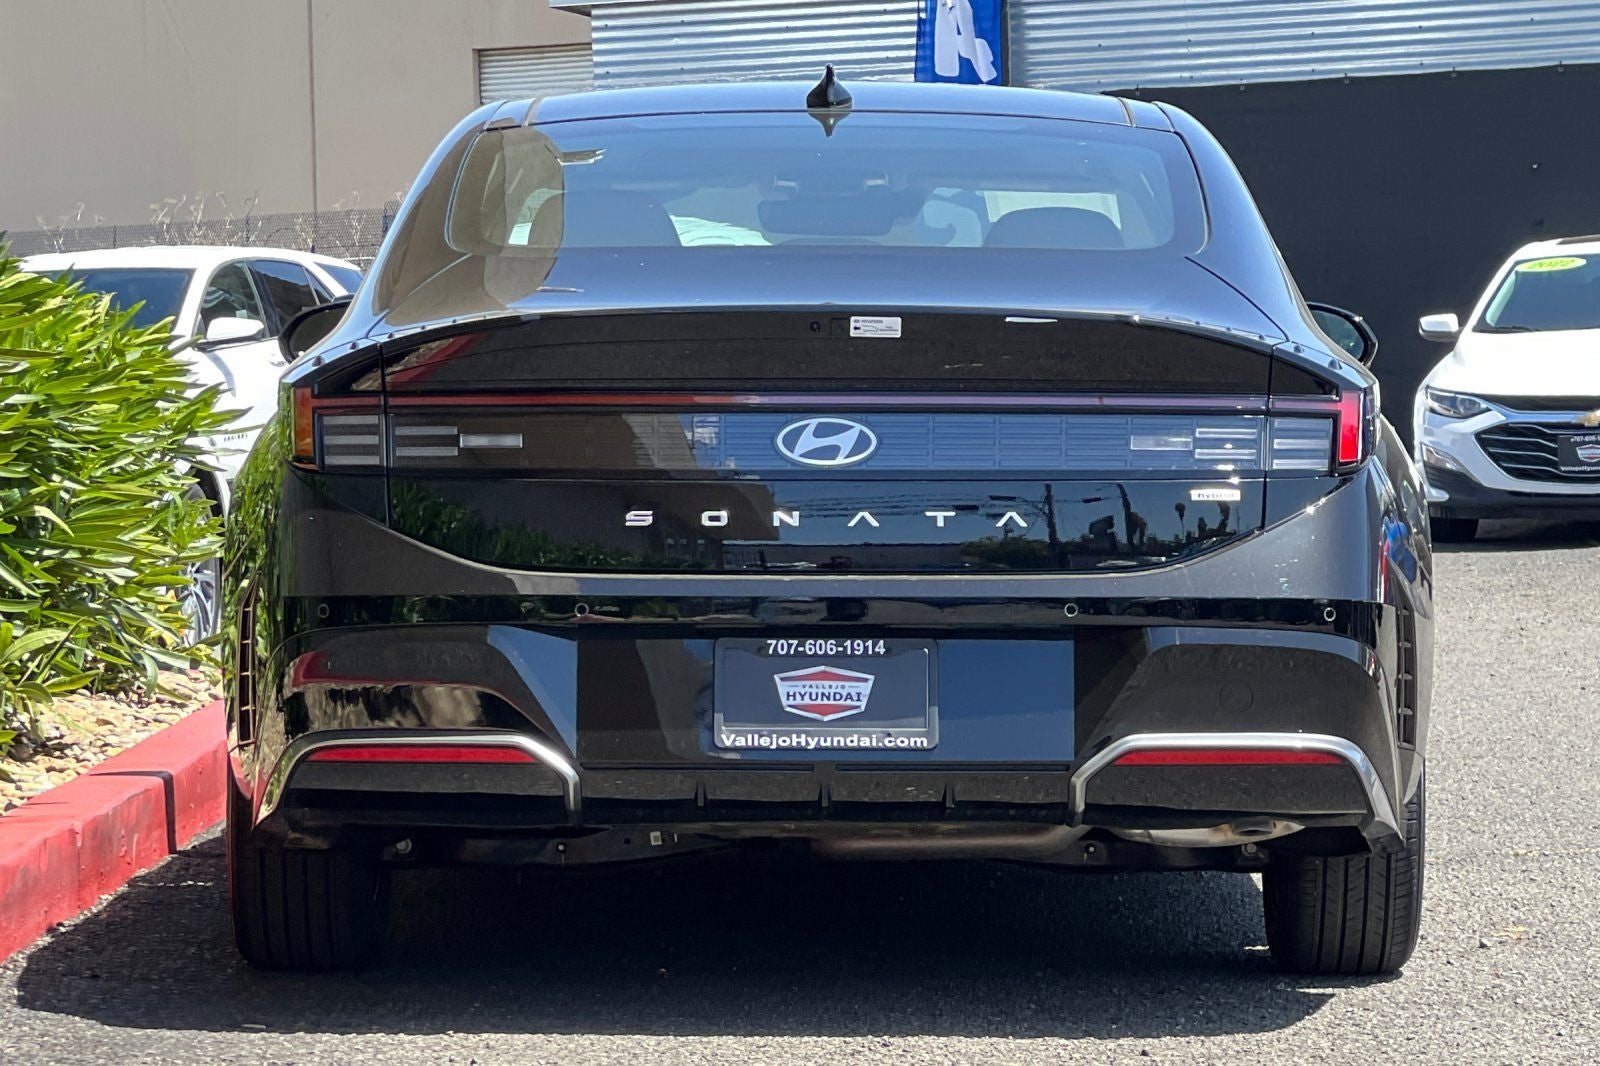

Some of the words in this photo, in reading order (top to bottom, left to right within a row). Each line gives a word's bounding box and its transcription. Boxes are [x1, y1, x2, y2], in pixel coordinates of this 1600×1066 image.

[624, 509, 1029, 528] SONATA
[766, 639, 887, 655] 707-606-1914
[785, 691, 863, 702] HYUNDAI
[720, 733, 929, 749] VallejoHyundai.com
